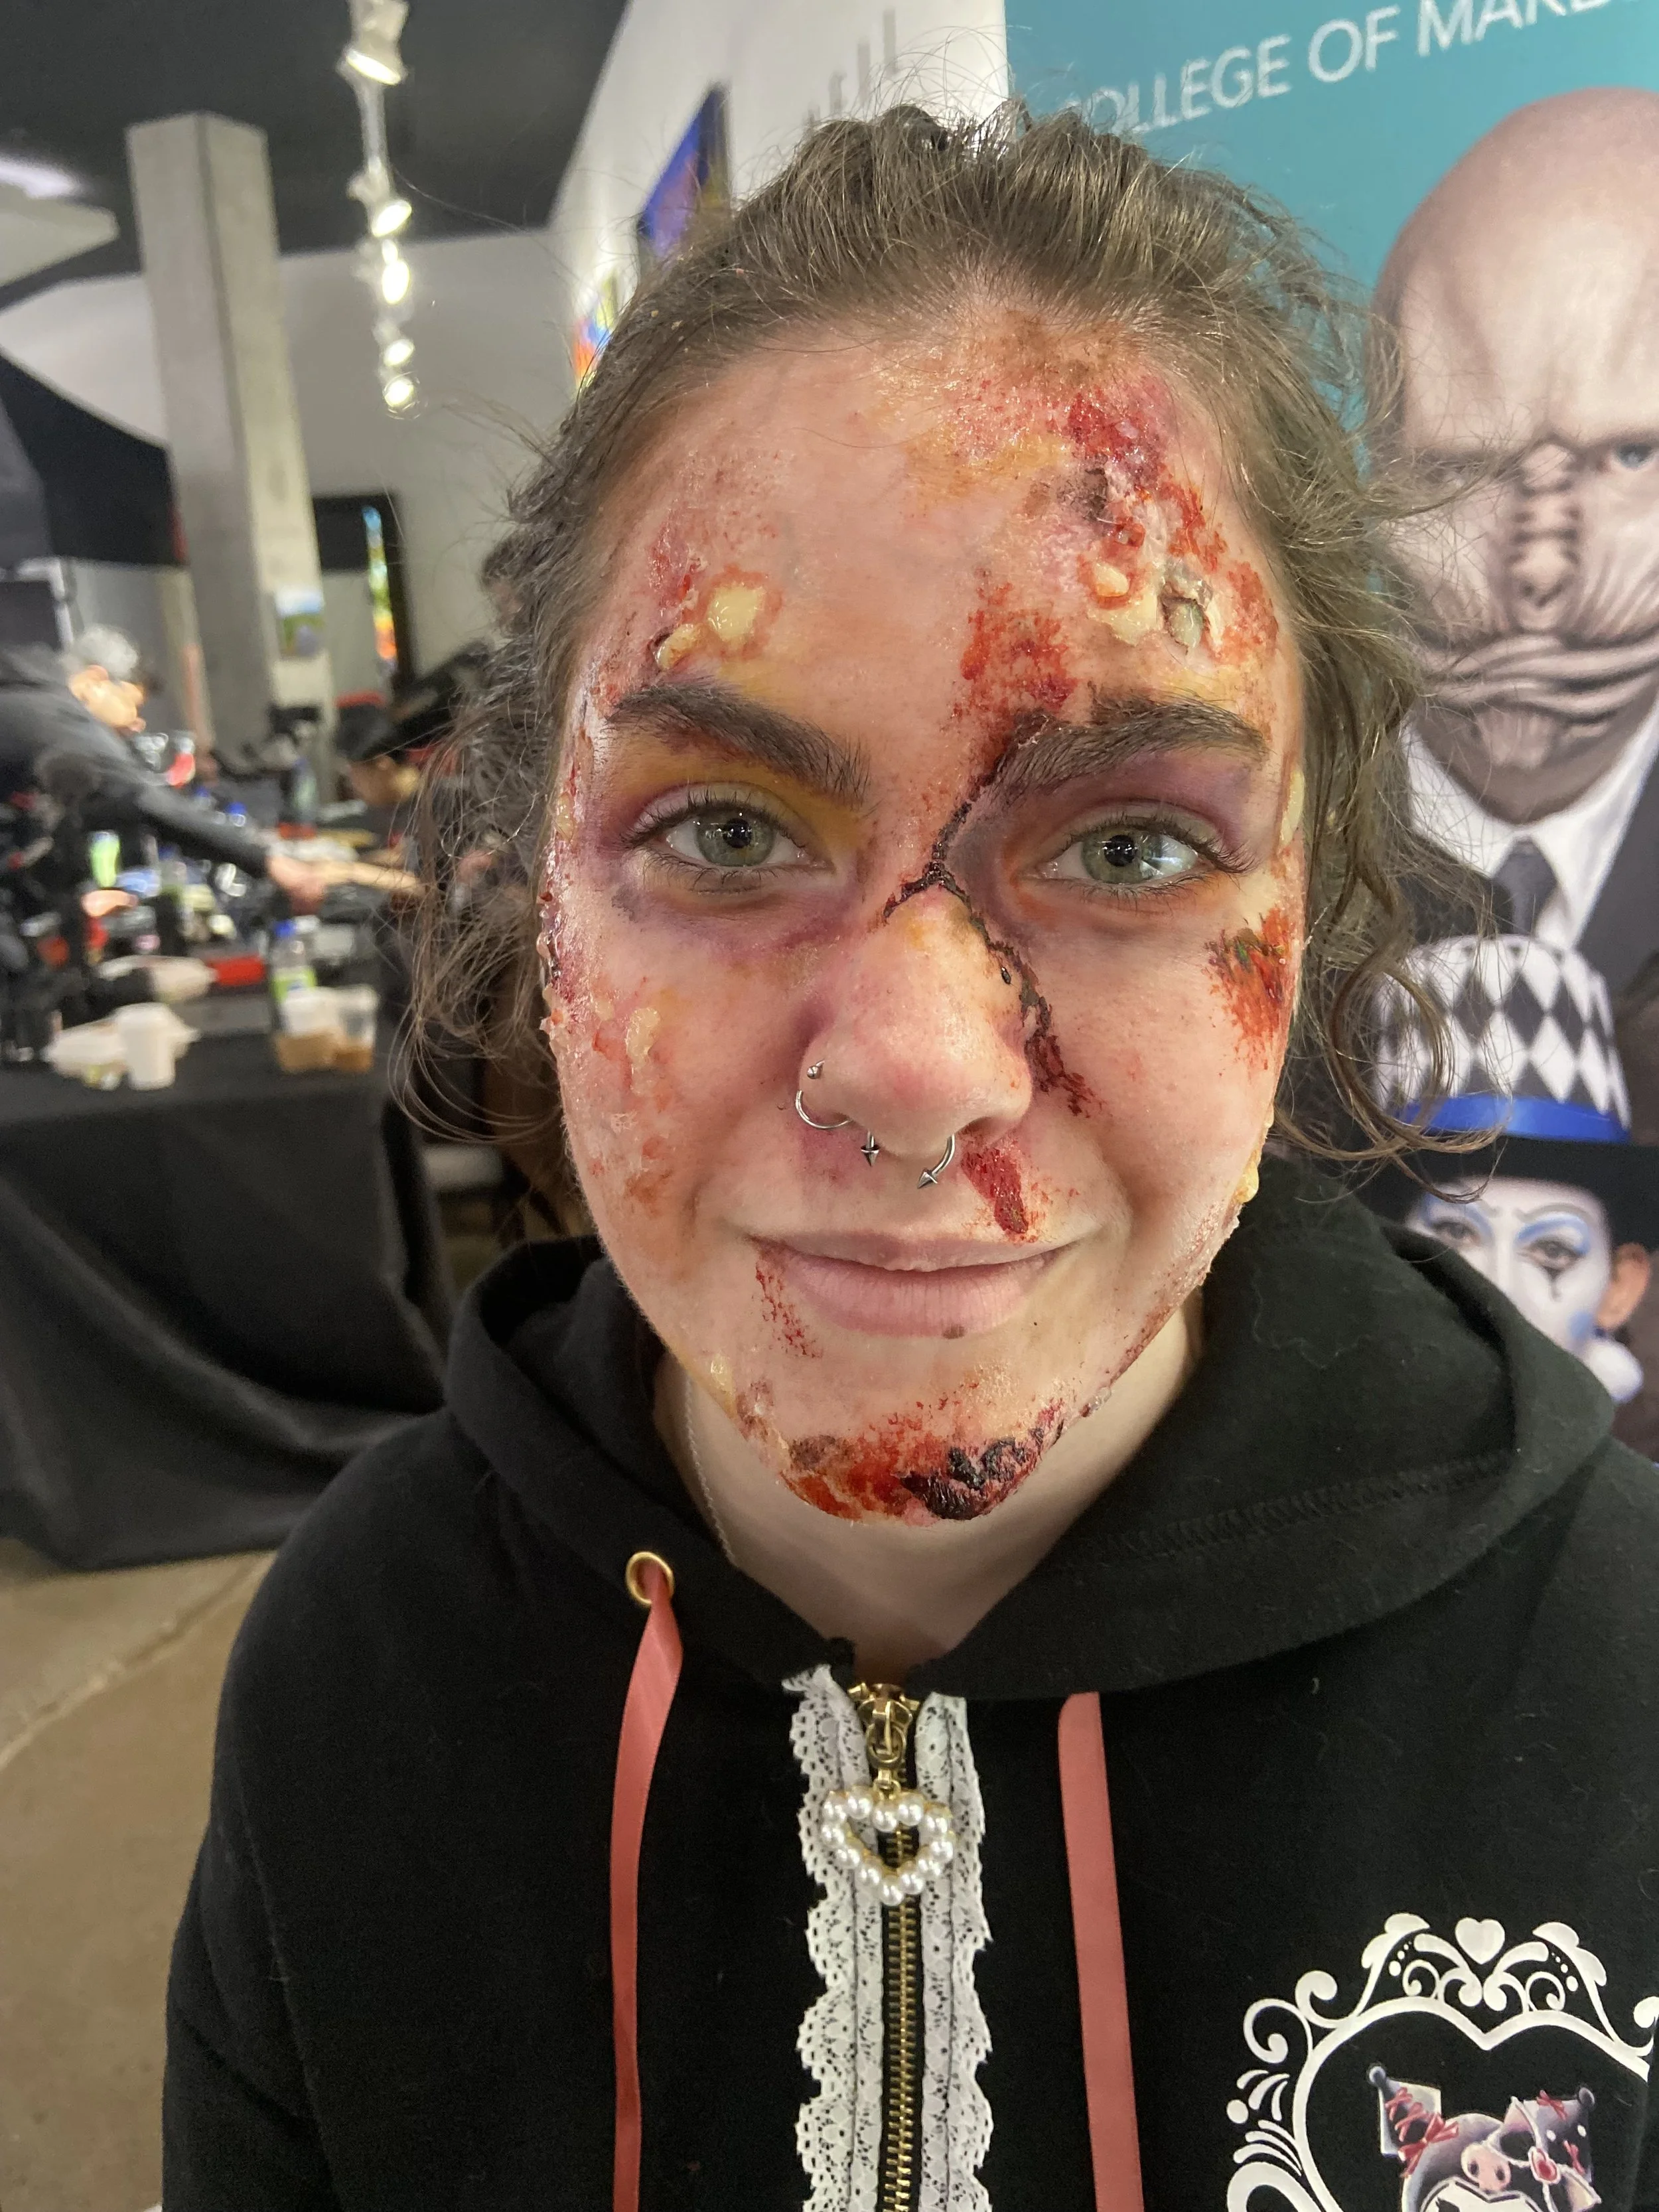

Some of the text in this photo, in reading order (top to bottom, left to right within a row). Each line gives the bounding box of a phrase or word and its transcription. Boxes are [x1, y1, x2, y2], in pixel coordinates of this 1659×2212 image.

[1063, 0, 1611, 135] OLLEGE OF MA
